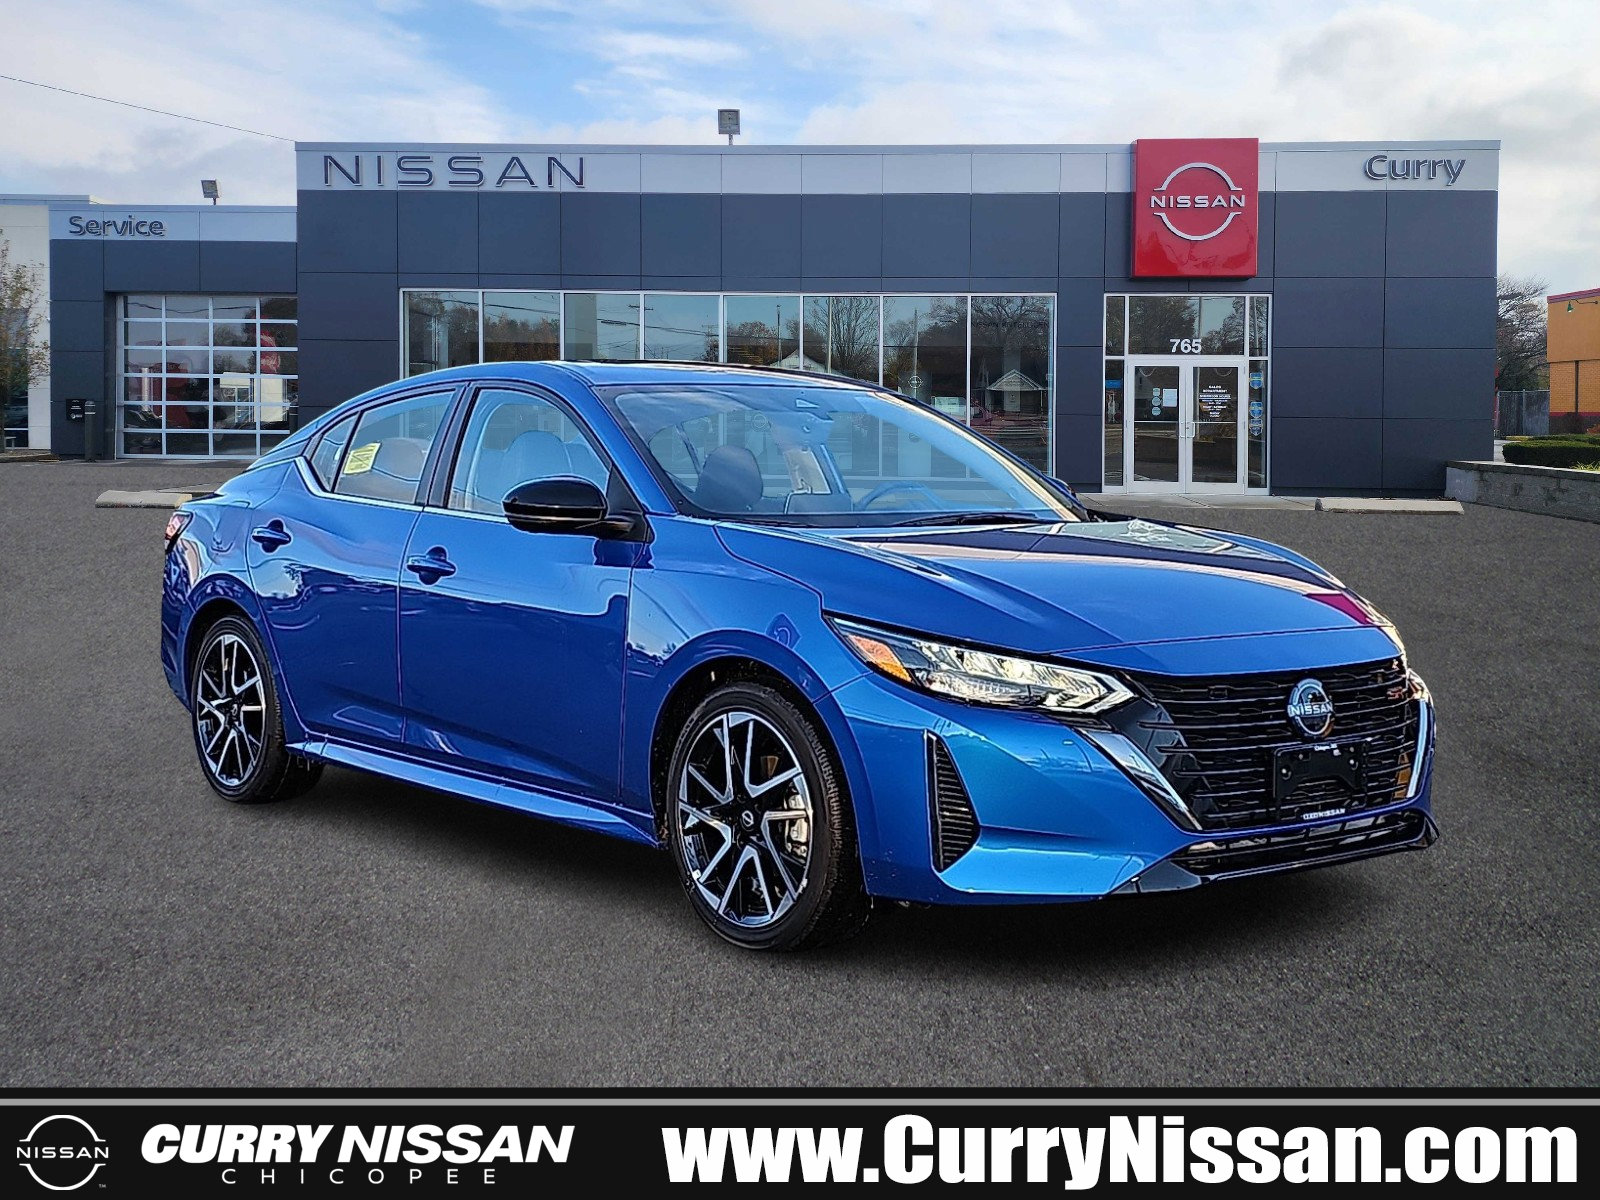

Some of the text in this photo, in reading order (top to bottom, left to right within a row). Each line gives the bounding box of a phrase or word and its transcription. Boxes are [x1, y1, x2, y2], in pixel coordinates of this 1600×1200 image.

[323, 155, 585, 188] NISSAN
[1363, 154, 1466, 187] Curry
[1150, 194, 1246, 209] NISSAN
[69, 214, 166, 236] Service
[1169, 338, 1202, 354] 765
[1291, 701, 1334, 716] NISSAN
